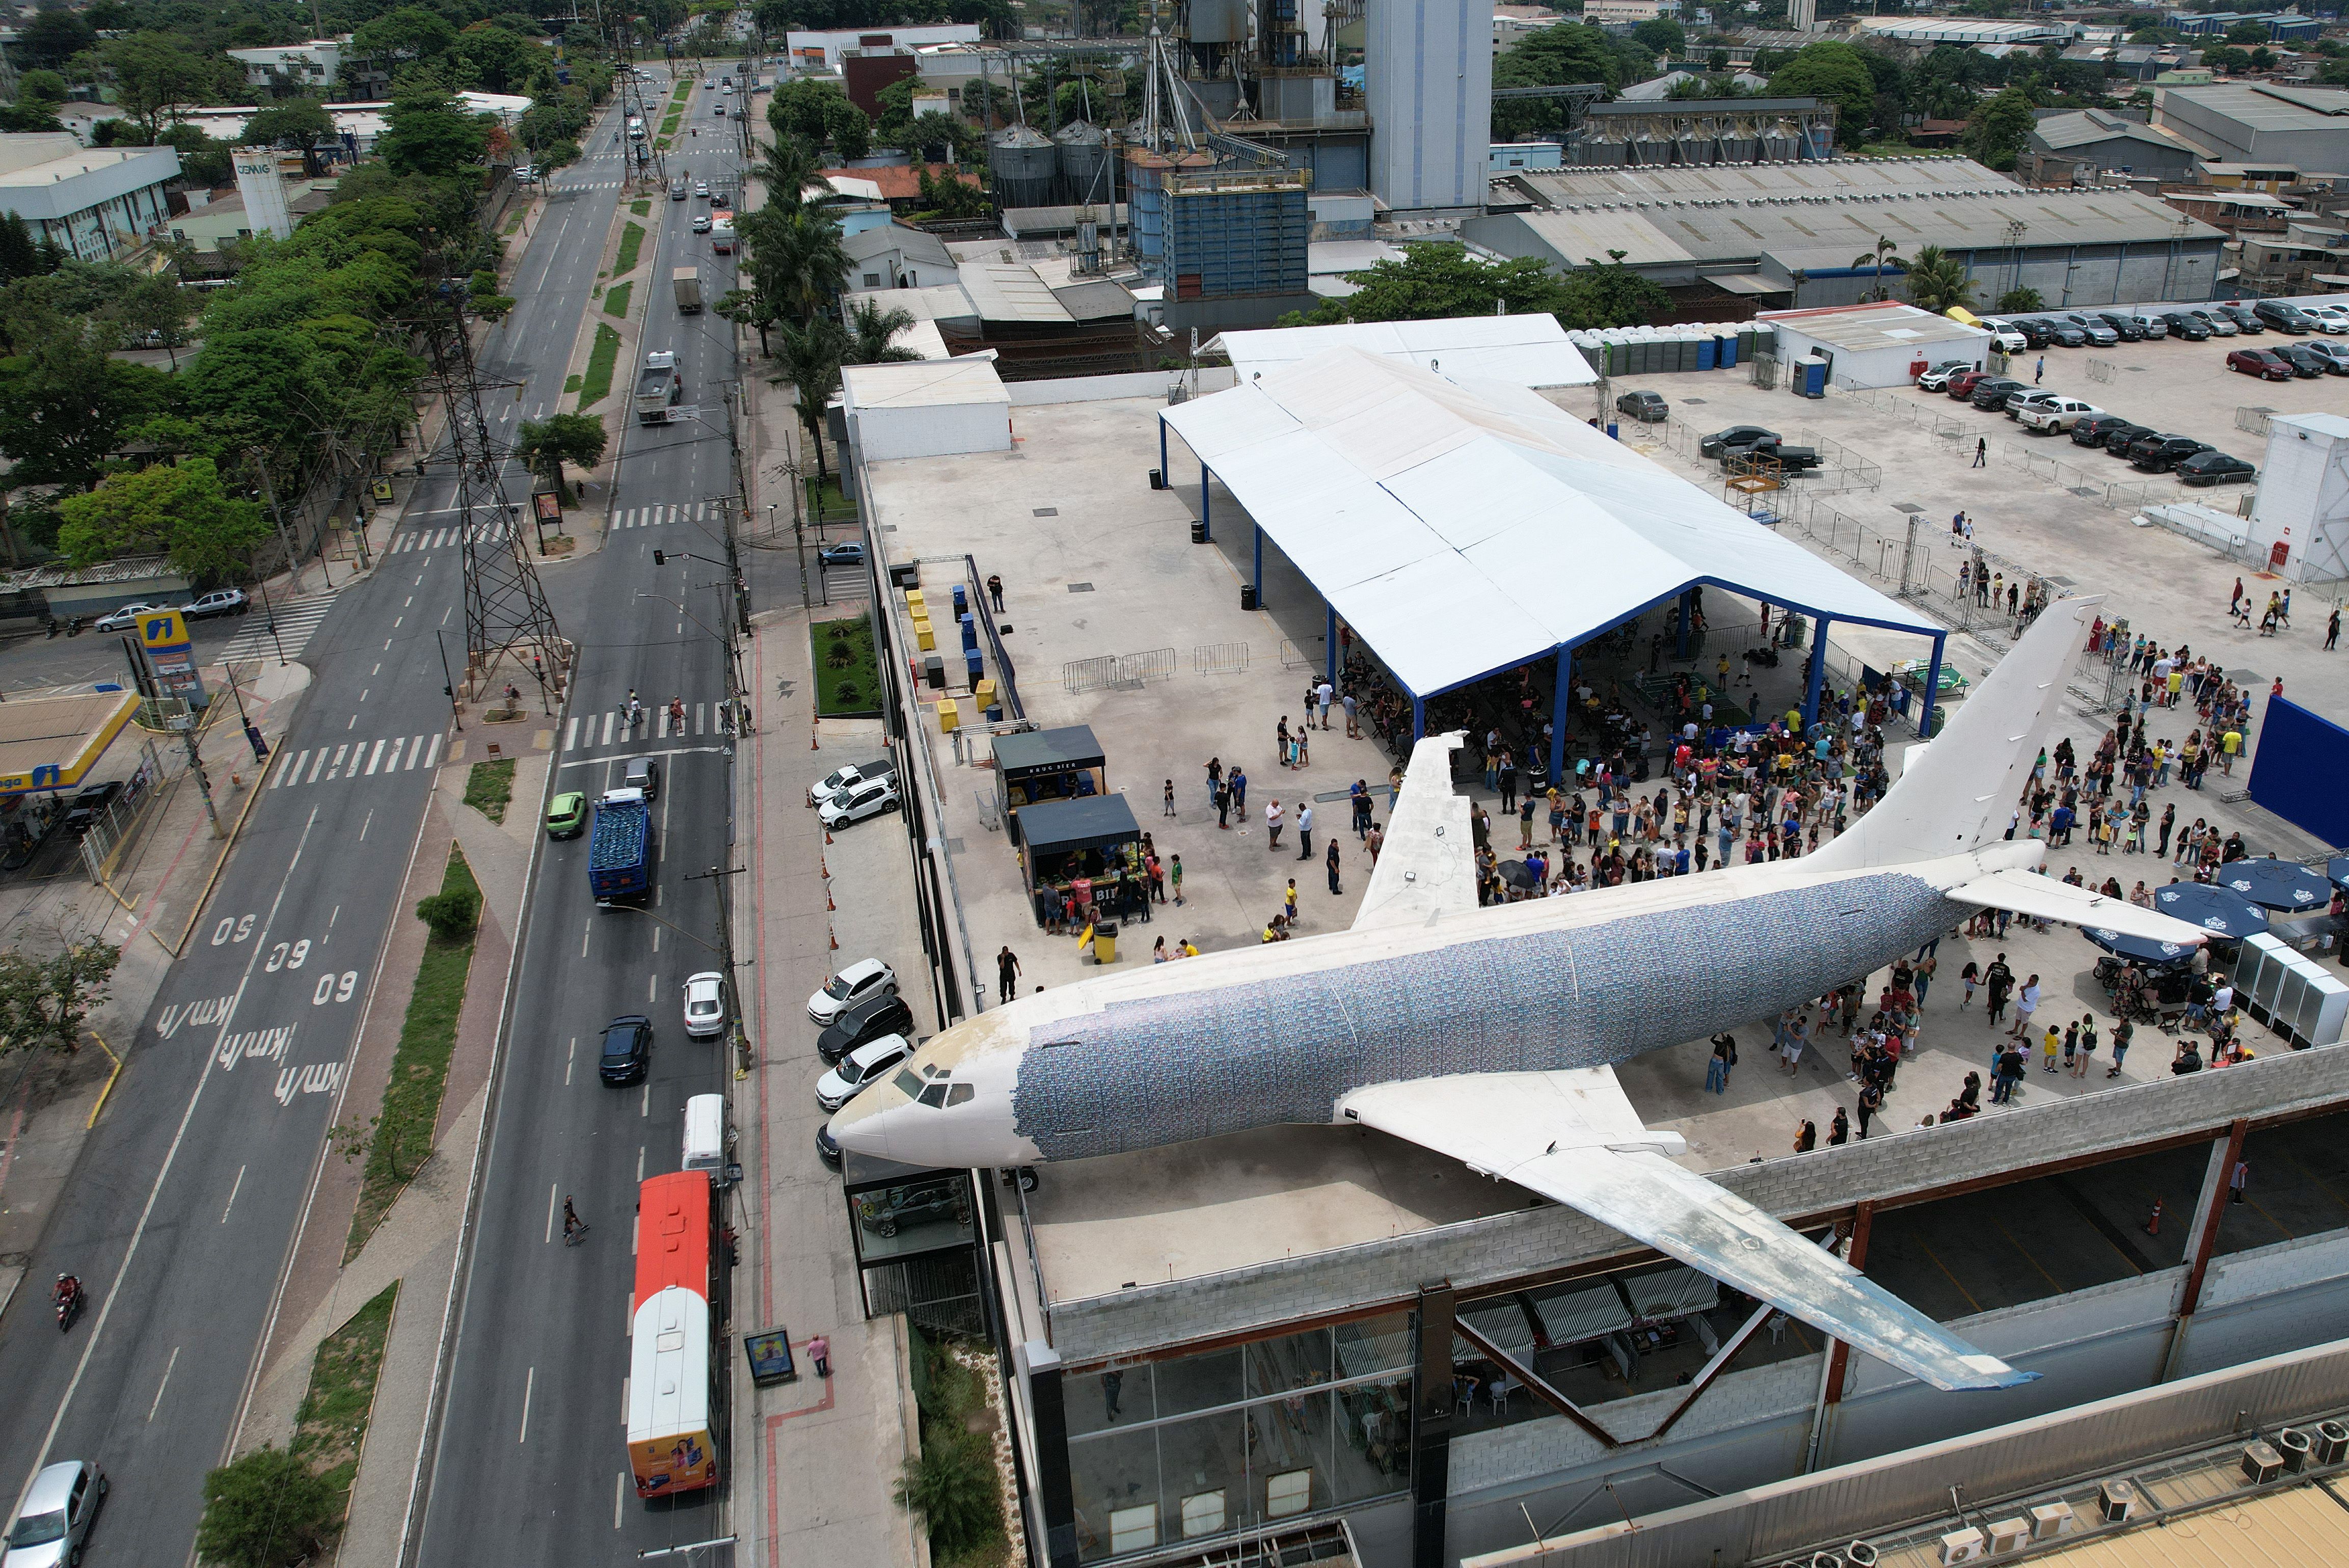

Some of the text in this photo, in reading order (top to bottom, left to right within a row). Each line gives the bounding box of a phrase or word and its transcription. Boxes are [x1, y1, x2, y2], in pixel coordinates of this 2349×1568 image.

[237, 164, 271, 174] CEMIG
[211, 914, 256, 946] 50
[264, 939, 311, 972] 60
[312, 970, 359, 1006] 60
[156, 995, 234, 1039] km/h
[218, 1026, 289, 1071] km/h
[274, 1062, 345, 1107] km/h
